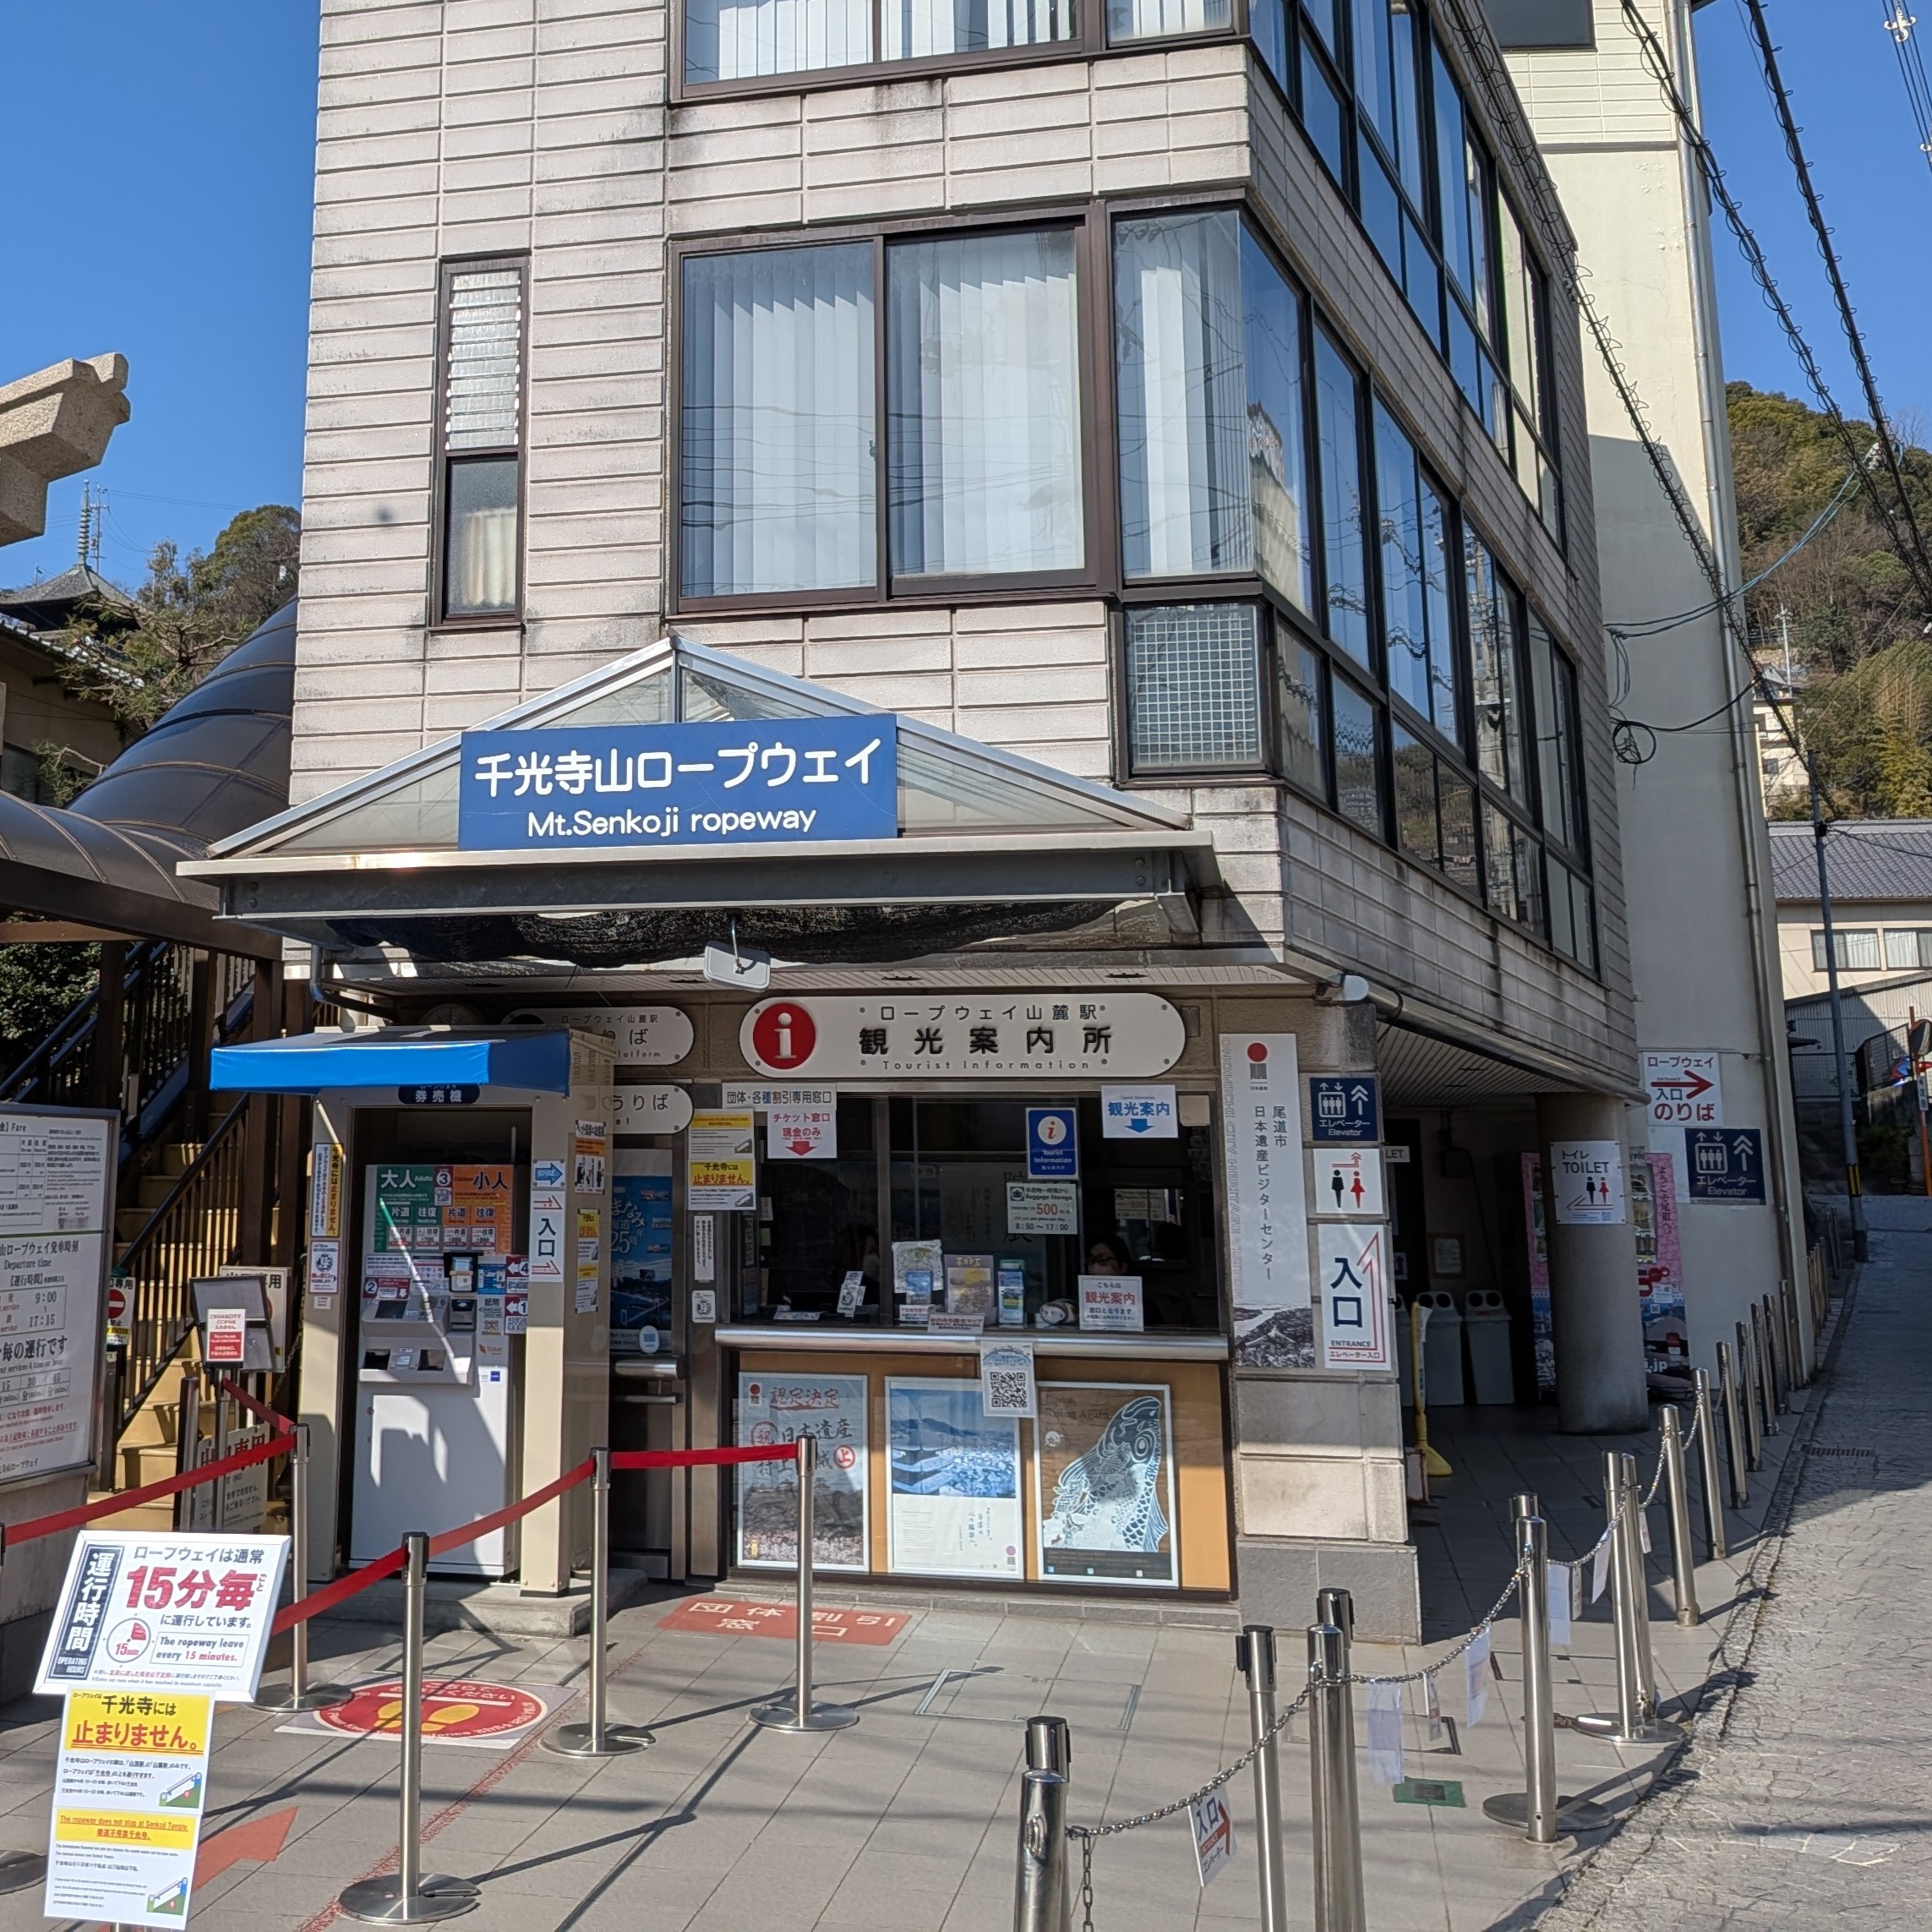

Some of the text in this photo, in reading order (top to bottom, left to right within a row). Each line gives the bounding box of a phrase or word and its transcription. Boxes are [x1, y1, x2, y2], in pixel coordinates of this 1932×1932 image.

[475, 738, 881, 798] 千光寺山ロープウェイ
[527, 806, 817, 838] Mt.Senkoji ropeway
[561, 1014, 658, 1024] ロープウェイ山麓駅
[880, 1004, 1098, 1022] ロープウェイ山麓駅
[859, 1025, 1112, 1056] 観光案内所
[882, 1060, 1089, 1070] Tourist Information
[1648, 1056, 1714, 1068] ロープウェイ
[415, 1089, 462, 1102] 券売機
[727, 1090, 832, 1105] 団体・各種割引専用窓口
[1656, 1088, 1683, 1101] 入口
[1107, 1101, 1171, 1116] 観光案内
[1654, 1103, 1715, 1122] のりば
[772, 1112, 831, 1123] チケット窓口
[1318, 1119, 1371, 1127] エレベーター
[11, 1123, 26, 1132] Fare
[782, 1127, 821, 1138] 現金のみ
[1272, 1105, 1288, 1148] 尾道市
[1563, 1149, 1590, 1160] トイレ
[1562, 1161, 1610, 1174] TOILET
[380, 1169, 417, 1189] 大人
[439, 1173, 449, 1185] 3
[472, 1171, 509, 1191] 小人
[693, 1174, 750, 1184] 止まりません。
[1696, 1176, 1756, 1186] エレベーター
[1254, 1105, 1274, 1280] 日本遺産ビジターセンター
[1707, 1187, 1747, 1195] Elevator
[391, 1206, 496, 1218] 片道 往復 片道 往復
[1036, 1203, 1058, 1215] 500
[538, 1217, 557, 1258] 入口
[3, 1258, 52, 1270] Departure time
[521, 1263, 529, 1274] 4
[367, 1283, 374, 1292] 2
[1329, 1257, 1363, 1329] 入口
[35, 1291, 57, 1304] 9:00
[1084, 1291, 1136, 1305] 観光案内
[30, 1313, 55, 1328] 17:15
[2, 1335, 68, 1362] 毎の運行です
[28, 1376, 36, 1388] 30
[52, 1373, 62, 1384] 45
[134, 1546, 265, 1564] ロープウェイは通常
[126, 1565, 258, 1612] 15分毎
[255, 1573, 268, 1592] ごと
[65, 1552, 116, 1652] 運行時間
[160, 1613, 253, 1629] に運行しています。
[160, 1636, 244, 1649] The ropeway leave
[156, 1651, 238, 1662] every 15 minutes.
[101, 1695, 177, 1716] 千光寺には
[72, 1719, 197, 1750] 止まりません。
[60, 1815, 71, 1824] The
[72, 1816, 96, 1826] ropeway
[98, 1817, 112, 1826] does
[1196, 1796, 1220, 1842] 入口
